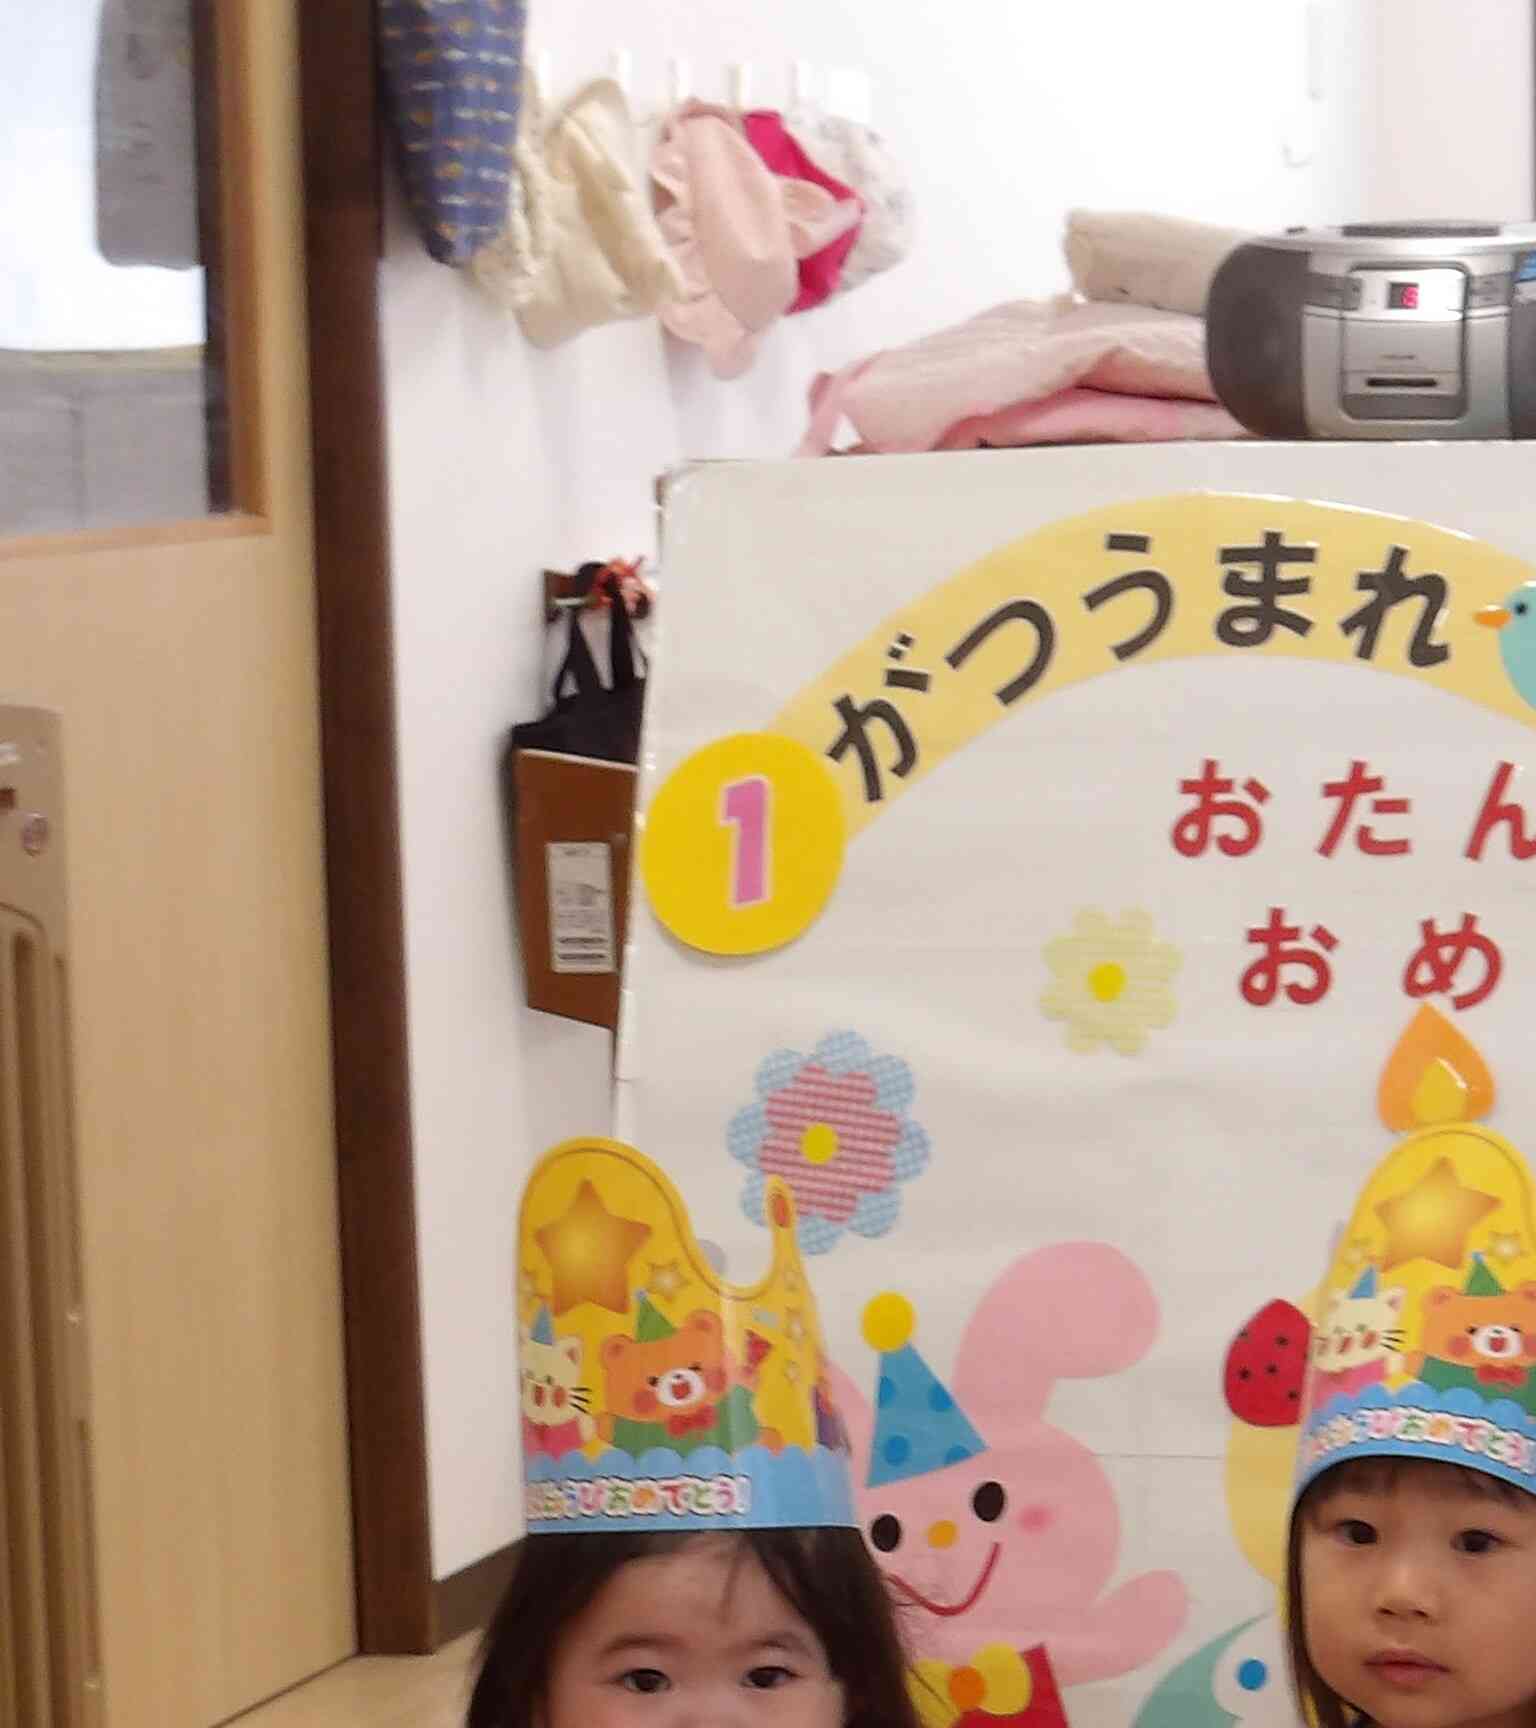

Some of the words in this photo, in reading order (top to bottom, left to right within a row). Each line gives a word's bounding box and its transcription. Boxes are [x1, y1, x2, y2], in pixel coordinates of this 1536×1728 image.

[718, 776, 769, 904] 1
[825, 530, 1451, 801] がつうまれ
